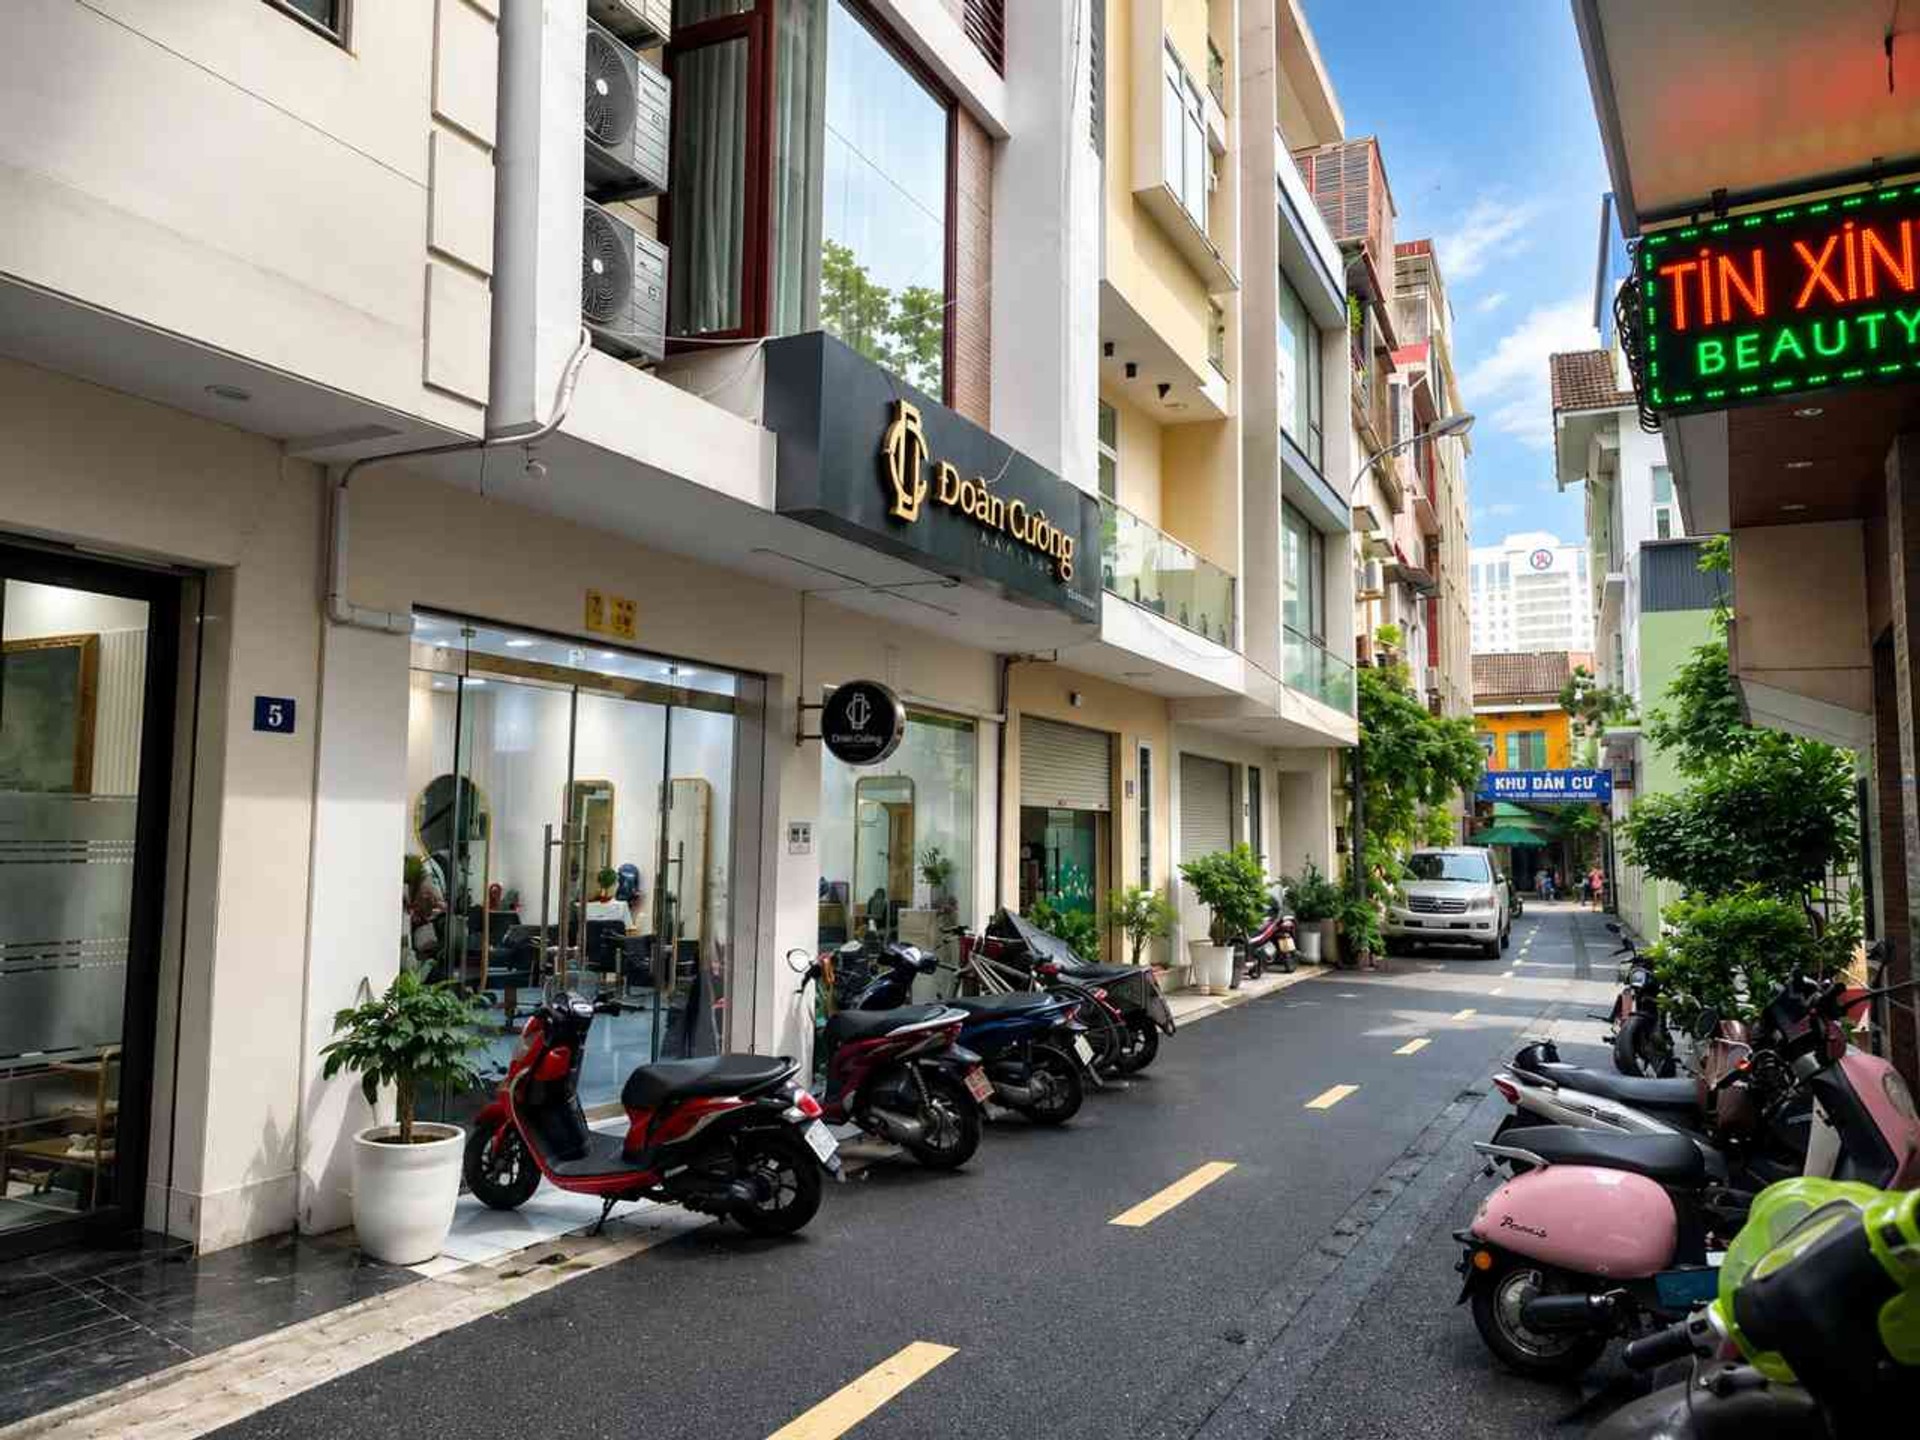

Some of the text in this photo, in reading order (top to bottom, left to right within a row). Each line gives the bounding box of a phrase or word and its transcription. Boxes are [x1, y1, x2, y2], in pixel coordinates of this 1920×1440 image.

[1698, 309, 1920, 376] BEAUTY
[937, 460, 1004, 530] Đoàn
[268, 704, 283, 727] 5
[1495, 772, 1598, 791] KHU DÂN CƯ
